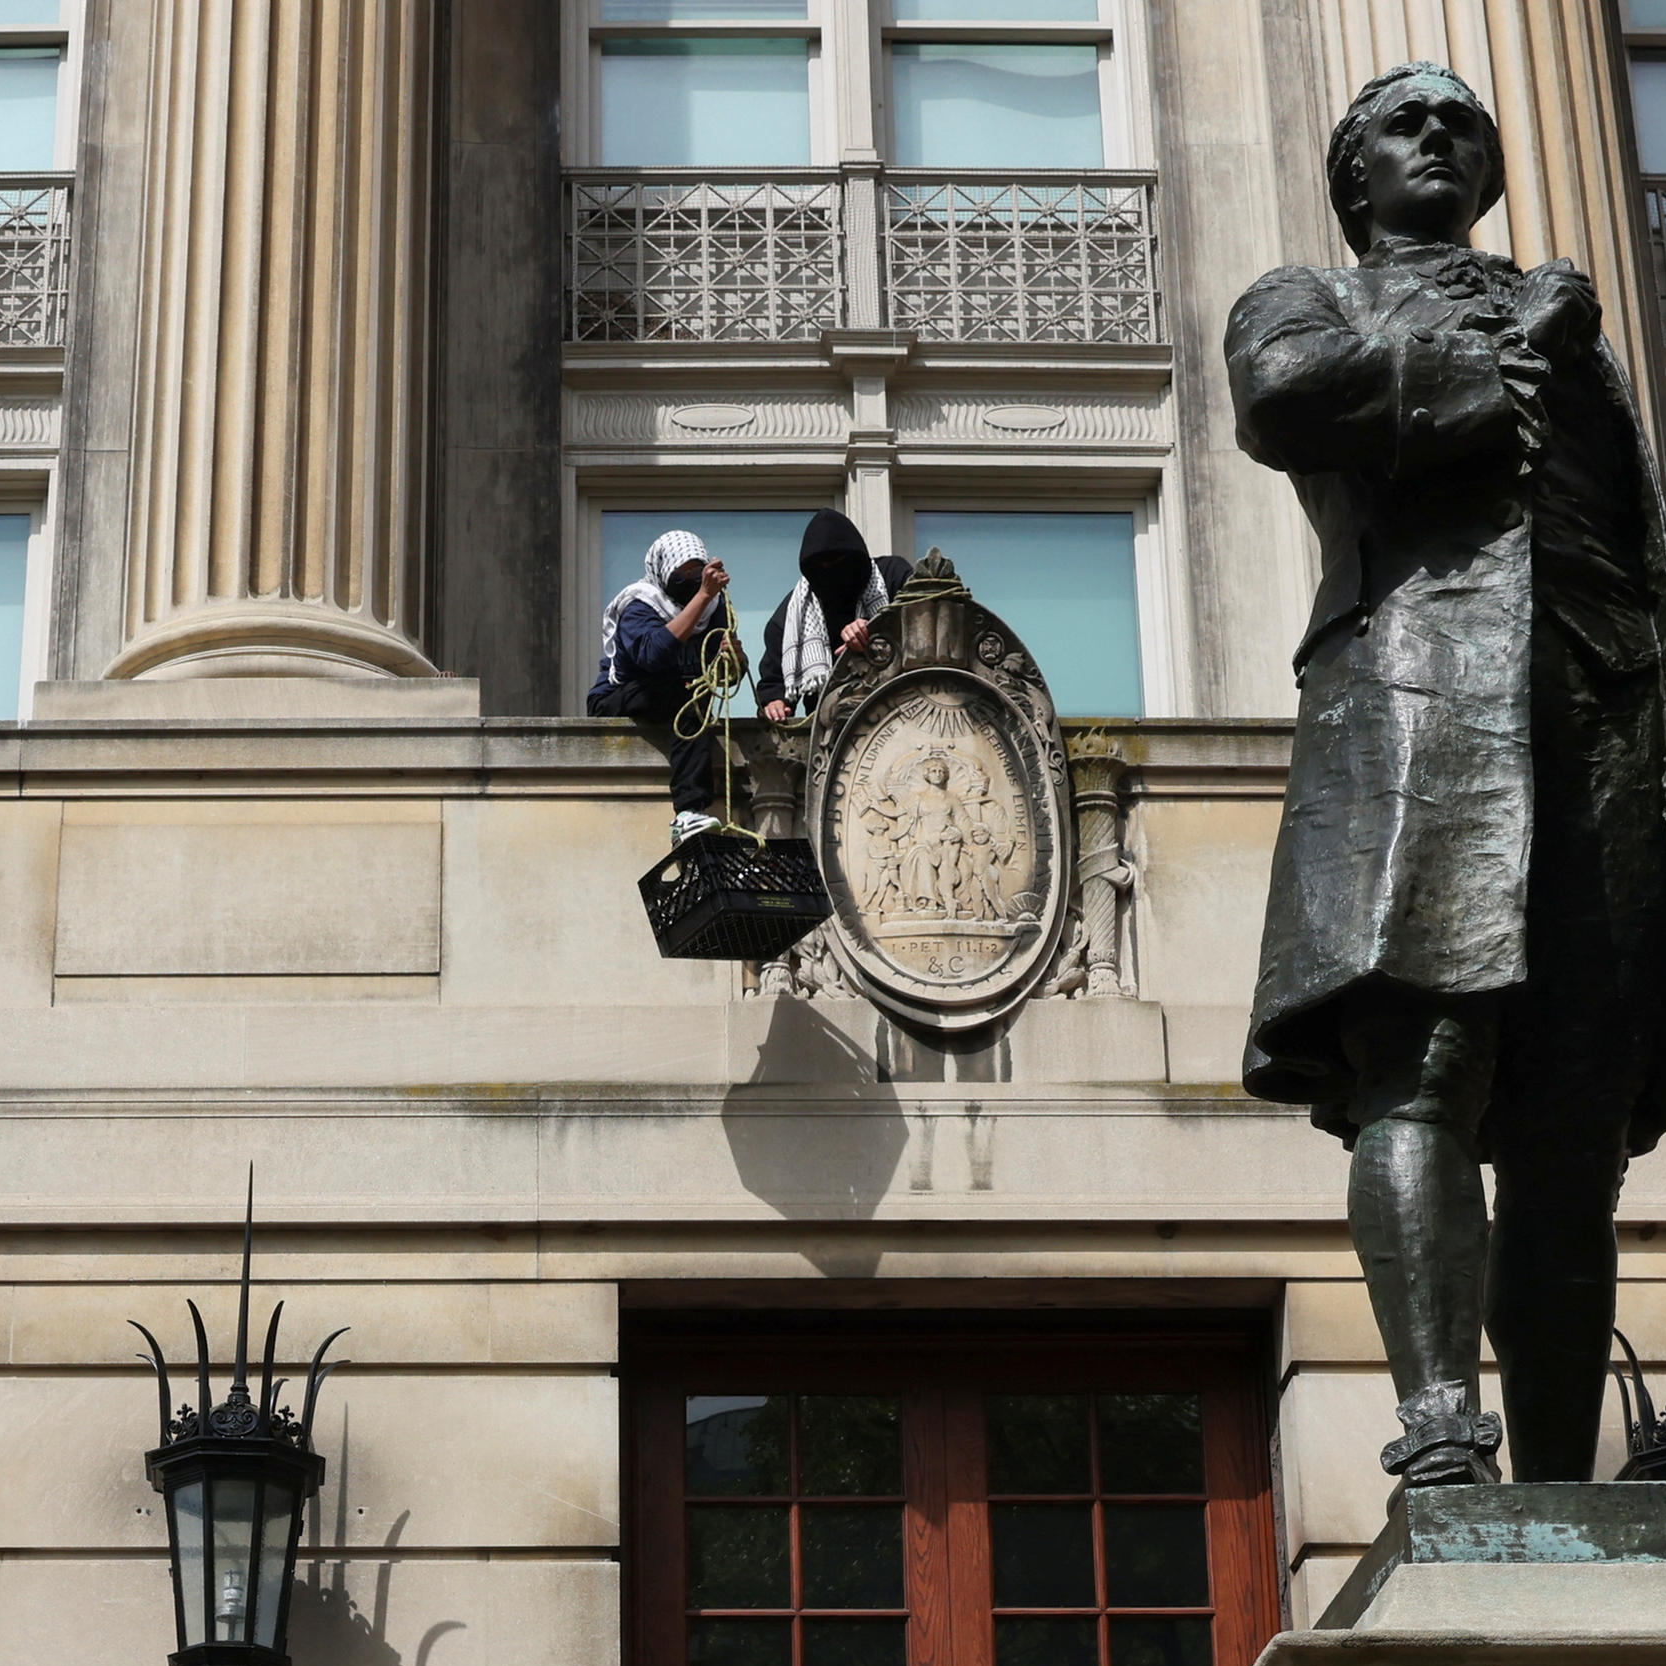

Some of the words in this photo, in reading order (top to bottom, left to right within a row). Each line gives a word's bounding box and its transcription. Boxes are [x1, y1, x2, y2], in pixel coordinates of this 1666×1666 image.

[861, 725, 899, 773] LUMINE
[855, 773, 870, 787] IN
[1012, 793, 1028, 851] LUMEN
